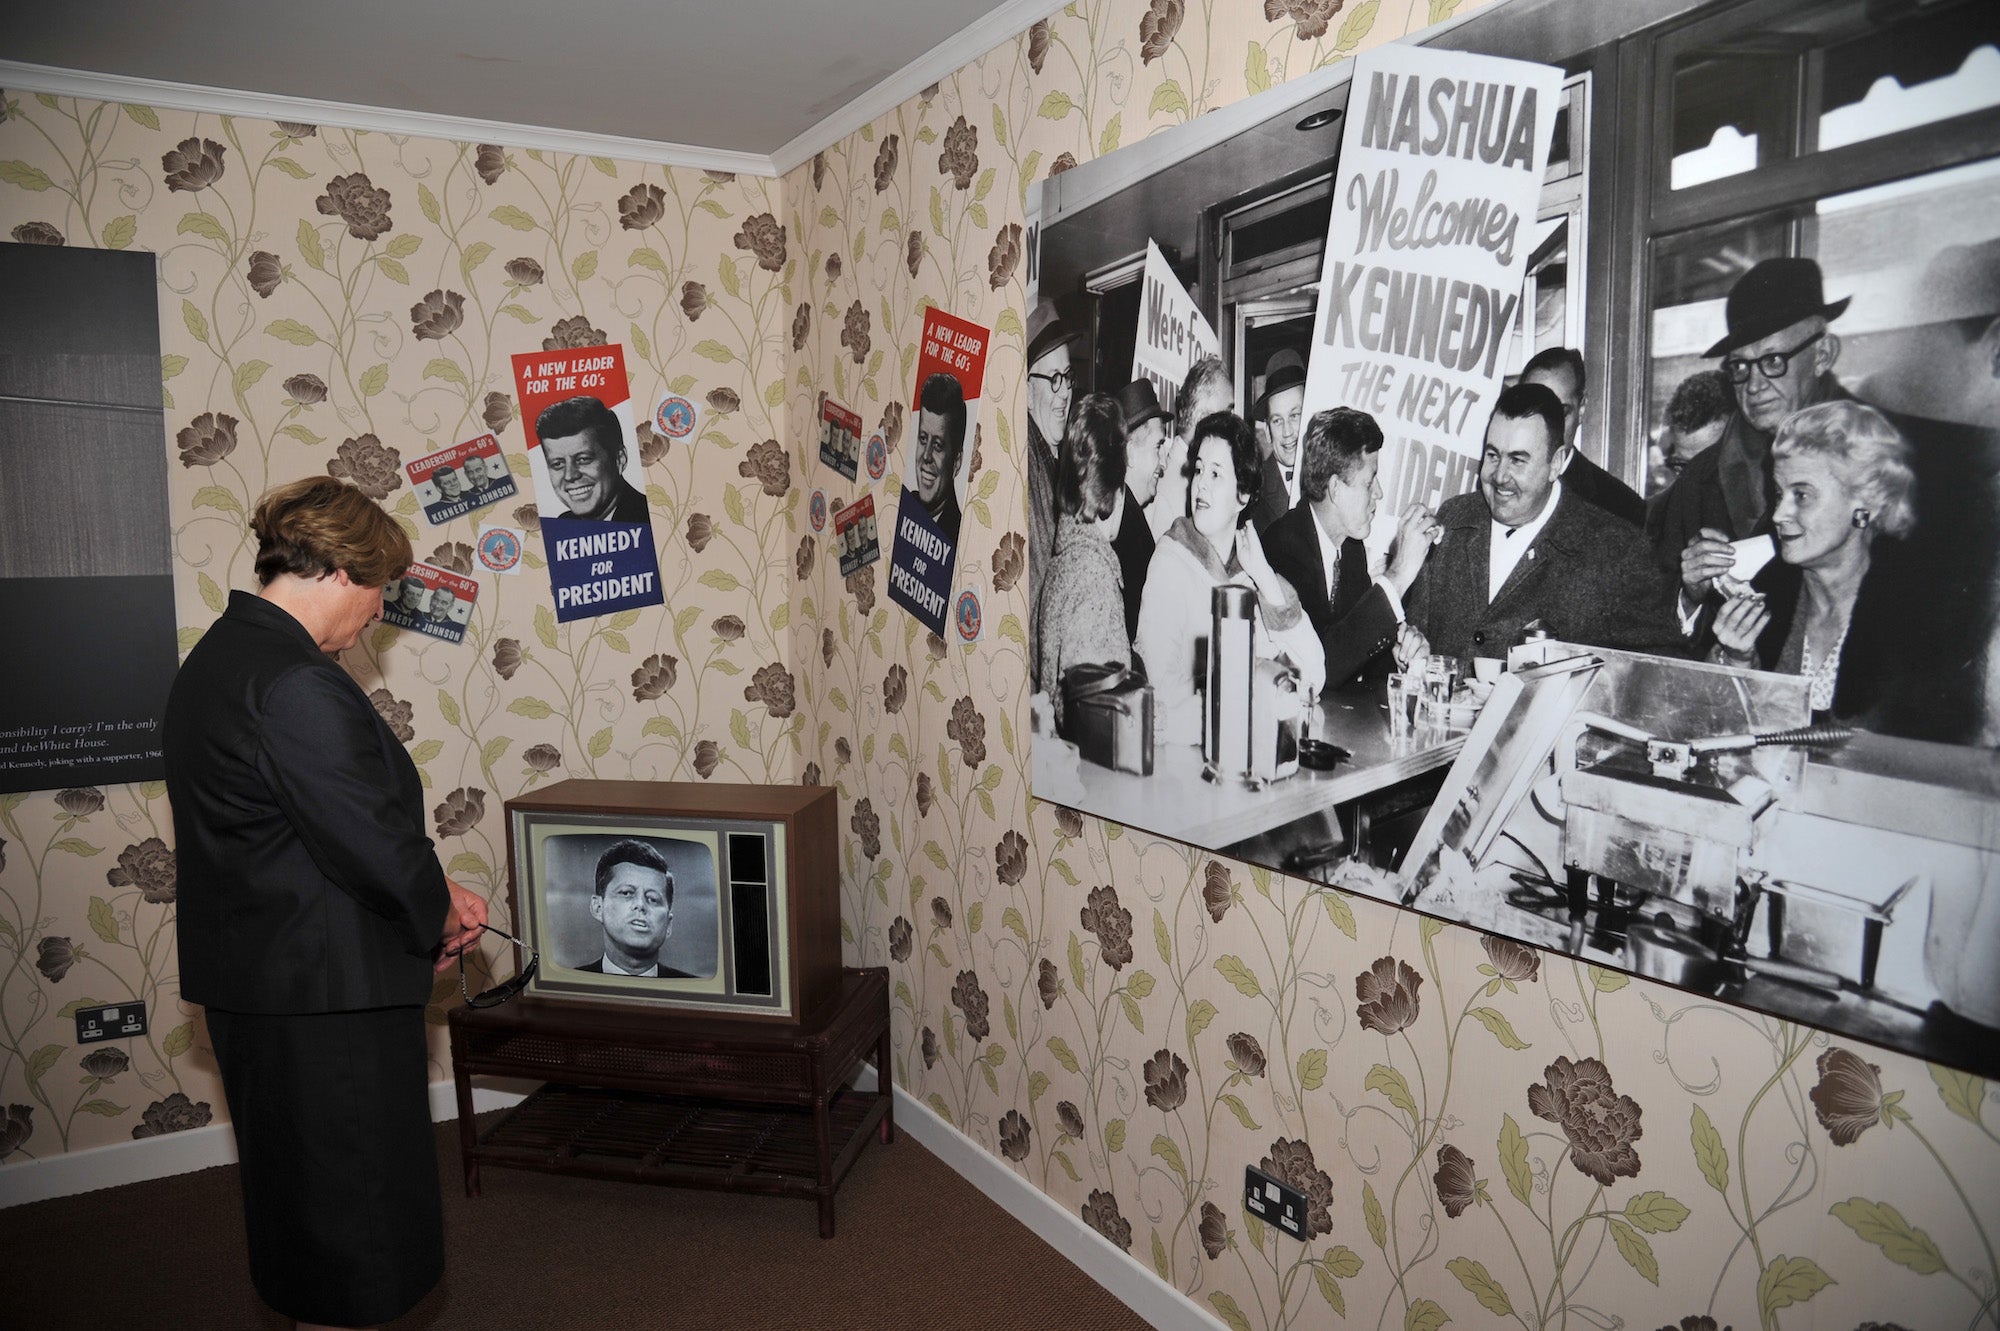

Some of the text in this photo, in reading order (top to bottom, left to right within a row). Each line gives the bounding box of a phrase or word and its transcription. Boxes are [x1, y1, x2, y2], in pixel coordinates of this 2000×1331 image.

[1360, 71, 1538, 173] NASHUA
[1347, 168, 1520, 267] Welcomes
[1148, 276, 1184, 356] We're
[1324, 261, 1518, 380] KENNEDY
[925, 340, 971, 372] FOR THE 60's
[927, 322, 982, 356] A NEW LEADER
[523, 356, 614, 379] A NEW LEADER
[526, 373, 605, 395] FOR THE 60's
[1341, 361, 1480, 437] THE NEXT
[410, 450, 457, 474] LEADERSHIP
[476, 438, 494, 450] 60's
[1384, 436, 1481, 517] IDENT
[431, 484, 514, 523] KENNEDY JOHNSON
[556, 527, 642, 562] KENNEDY
[900, 516, 951, 566] KENNEDY
[407, 565, 439, 580] ERSHIP
[460, 582, 476, 593] 60's
[591, 560, 613, 577] FOR
[912, 557, 928, 576] FOR
[558, 572, 653, 609] PRESIDENT
[891, 563, 945, 619] PRESIDENT
[384, 611, 461, 641] NNEDY JOHNSON
[0, 718, 158, 739] onsibility I carry? I'm the only
[21, 742, 39, 752] the
[40, 740, 71, 751] White
[74, 738, 109, 748] House.
[9, 759, 47, 770] Kennedy,
[48, 757, 74, 768] joking
[76, 755, 94, 763] with
[102, 753, 143, 764] supporter,
